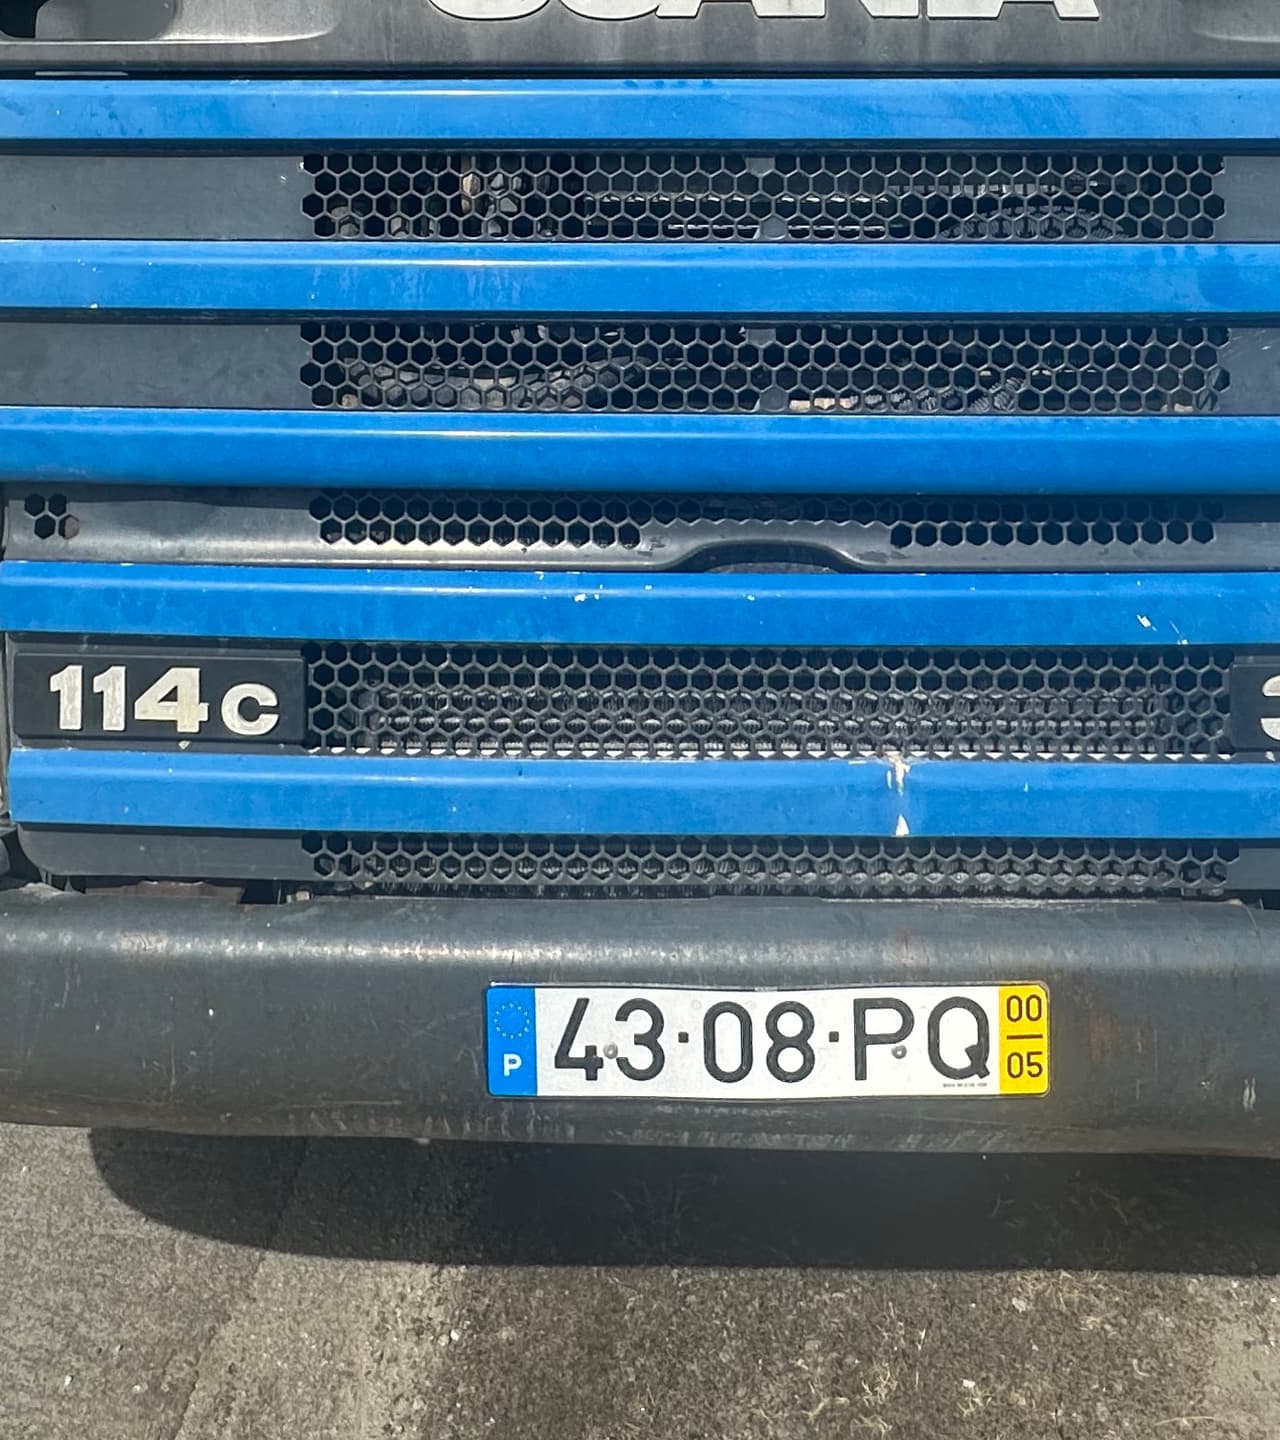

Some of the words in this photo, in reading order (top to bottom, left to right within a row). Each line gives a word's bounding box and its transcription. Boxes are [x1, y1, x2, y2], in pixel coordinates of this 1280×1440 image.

[1006, 994, 1042, 1022] 00
[503, 1053, 522, 1076] P
[1006, 1051, 1043, 1078] 05
